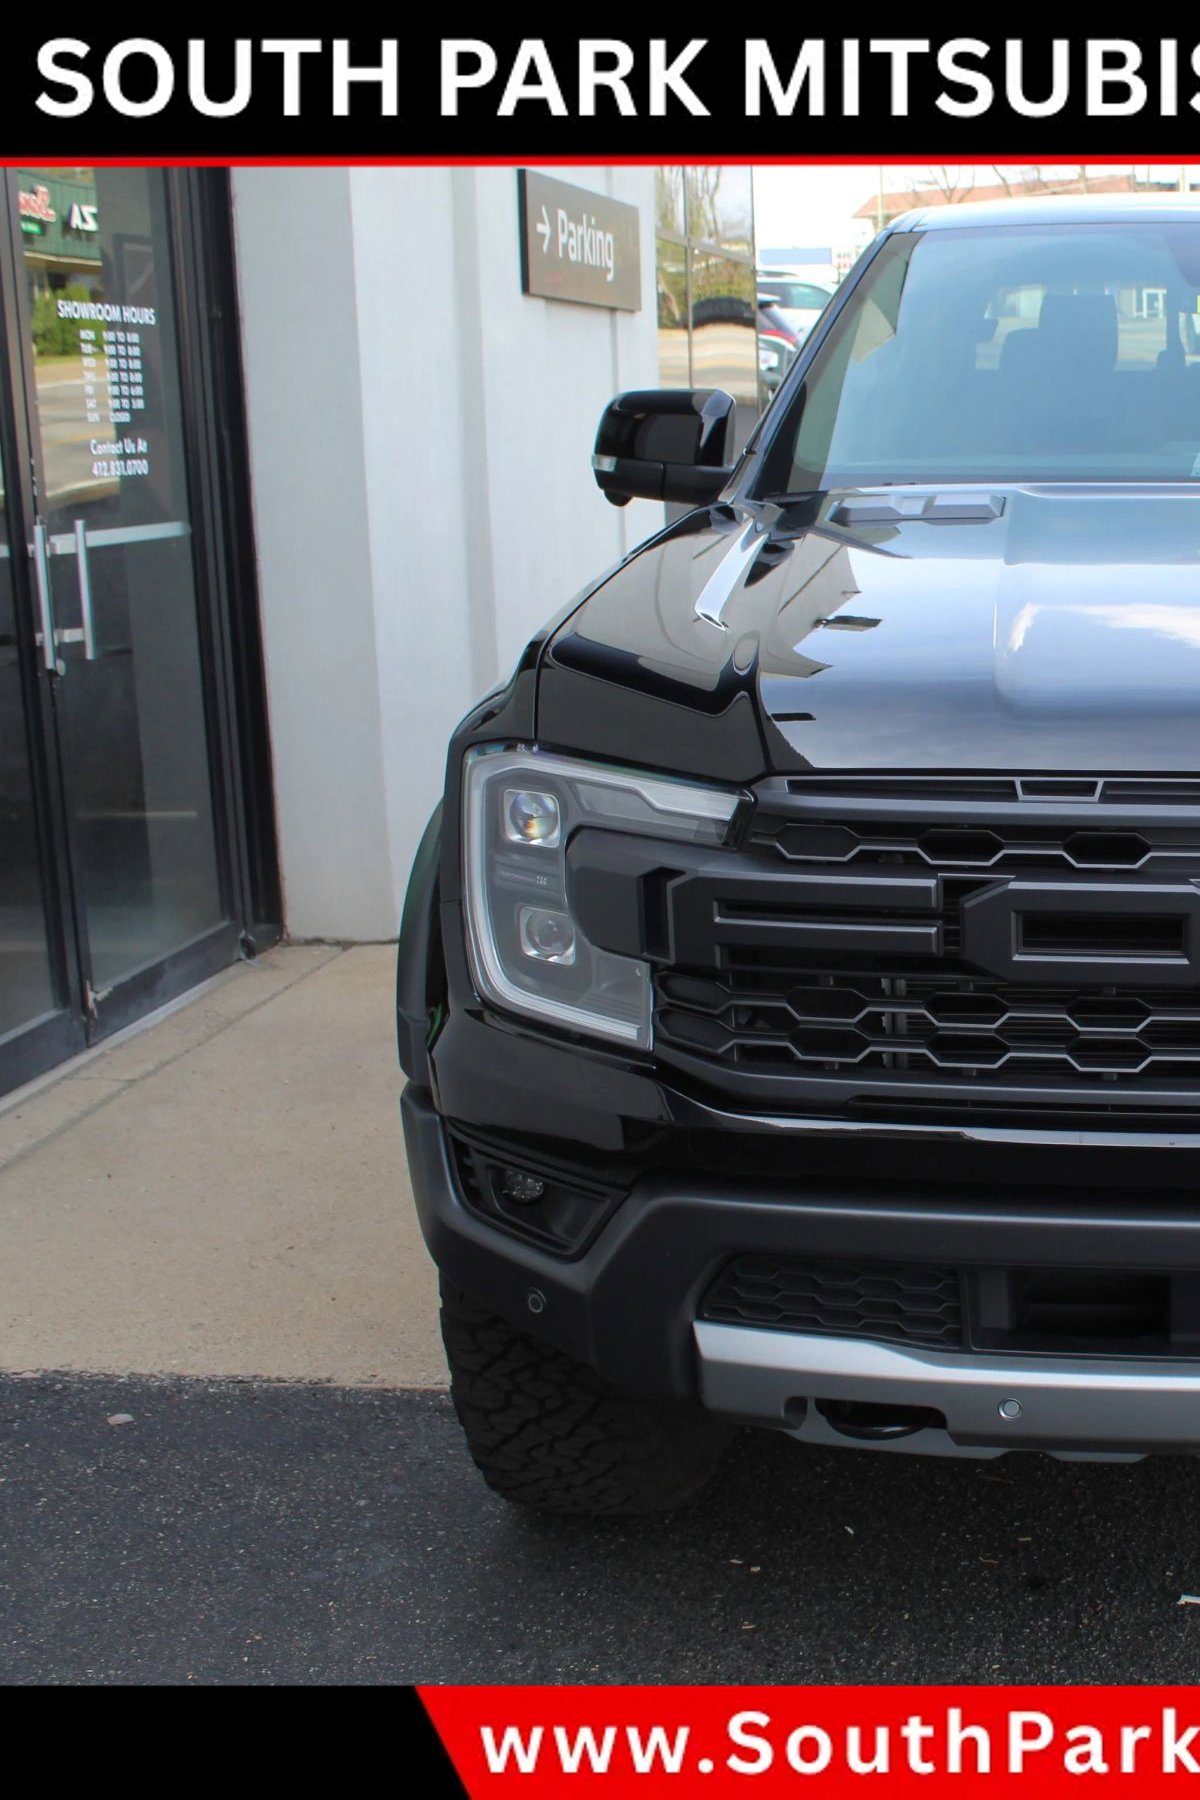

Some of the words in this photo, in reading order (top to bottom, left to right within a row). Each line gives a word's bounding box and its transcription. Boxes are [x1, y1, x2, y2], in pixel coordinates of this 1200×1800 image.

[557, 207, 614, 283] Parking
[57, 299, 122, 322] SHOWROOM
[121, 305, 156, 326] HOURS
[90, 439, 124, 455] Contact
[124, 438, 136, 454] Us
[137, 438, 147, 453] At
[92, 459, 149, 477] 412.831.0700
